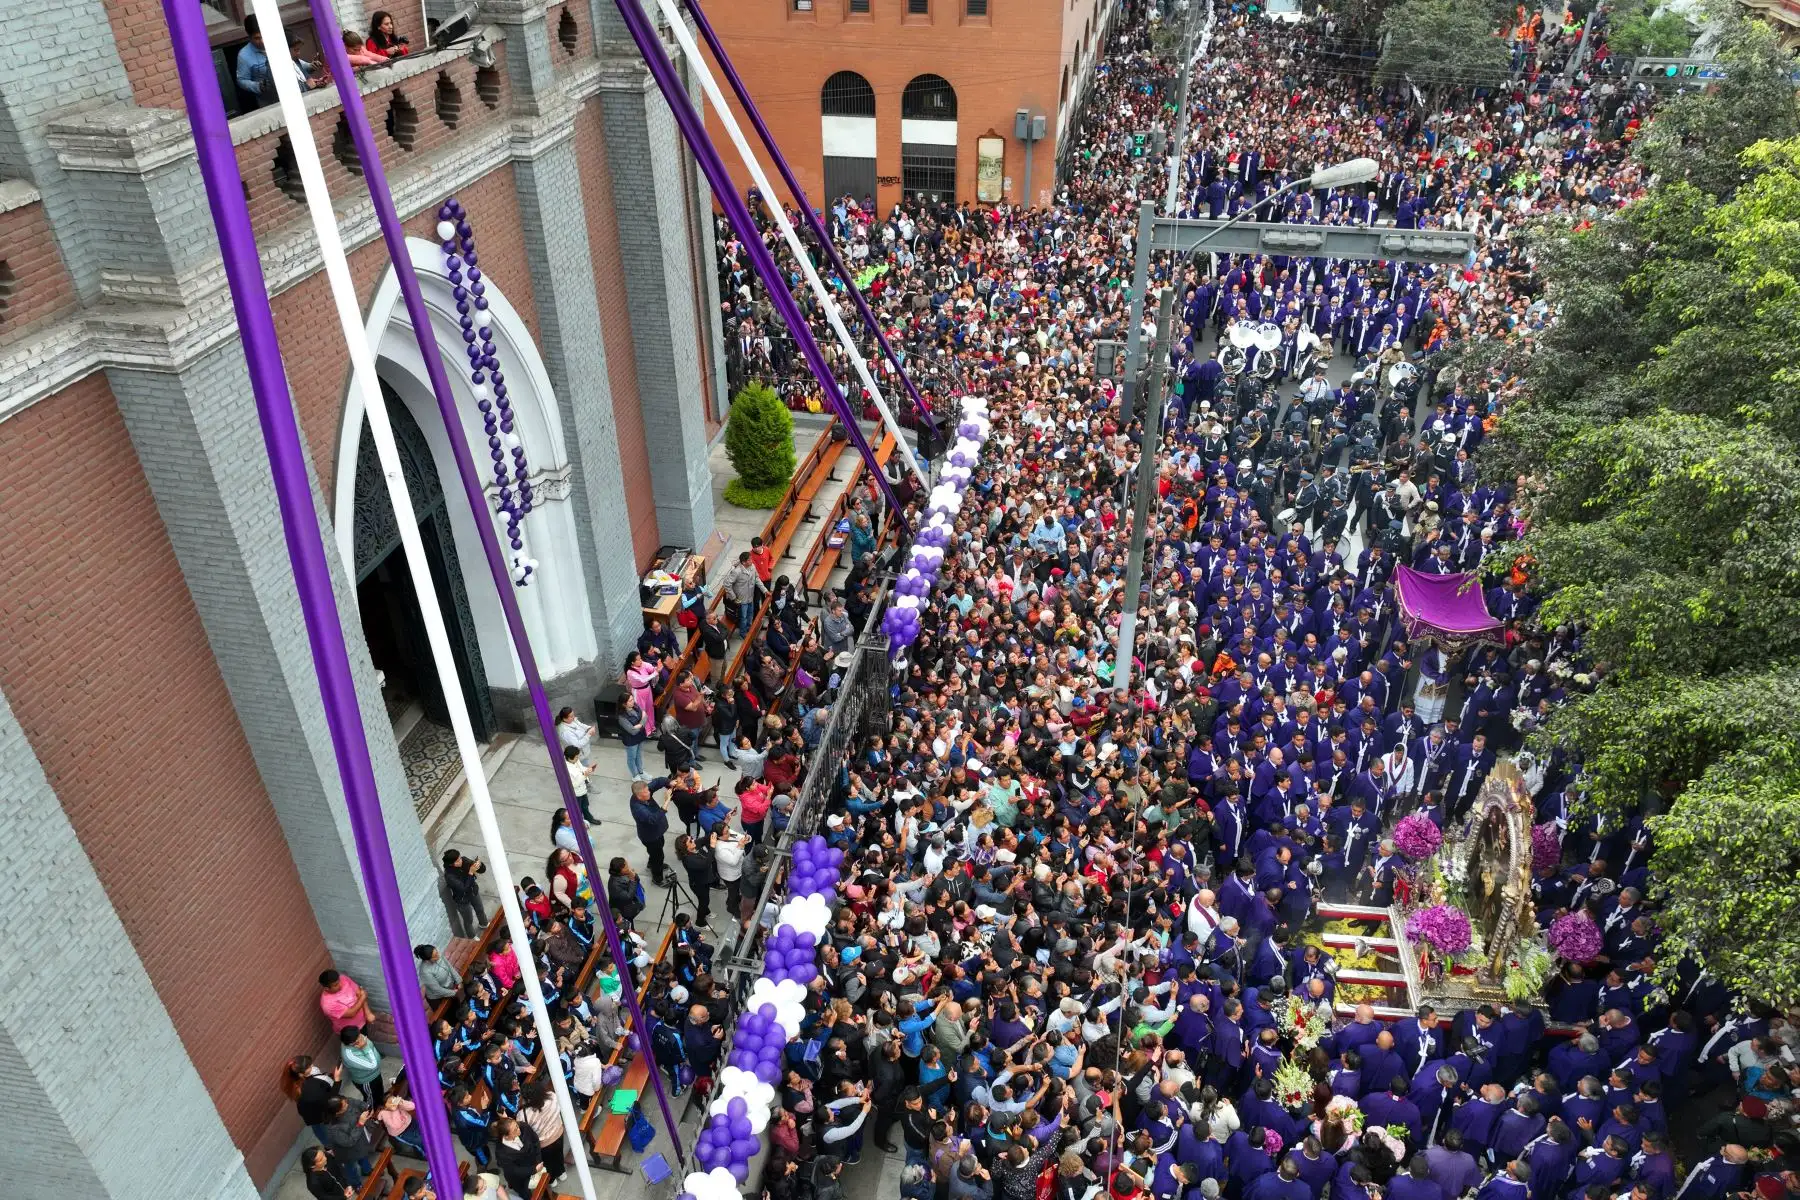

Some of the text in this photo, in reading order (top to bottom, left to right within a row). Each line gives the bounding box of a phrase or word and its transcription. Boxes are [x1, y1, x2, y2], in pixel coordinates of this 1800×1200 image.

[1238, 321, 1256, 330] FAP
[1257, 325, 1277, 334] FAP
[1395, 363, 1416, 373] FAP
